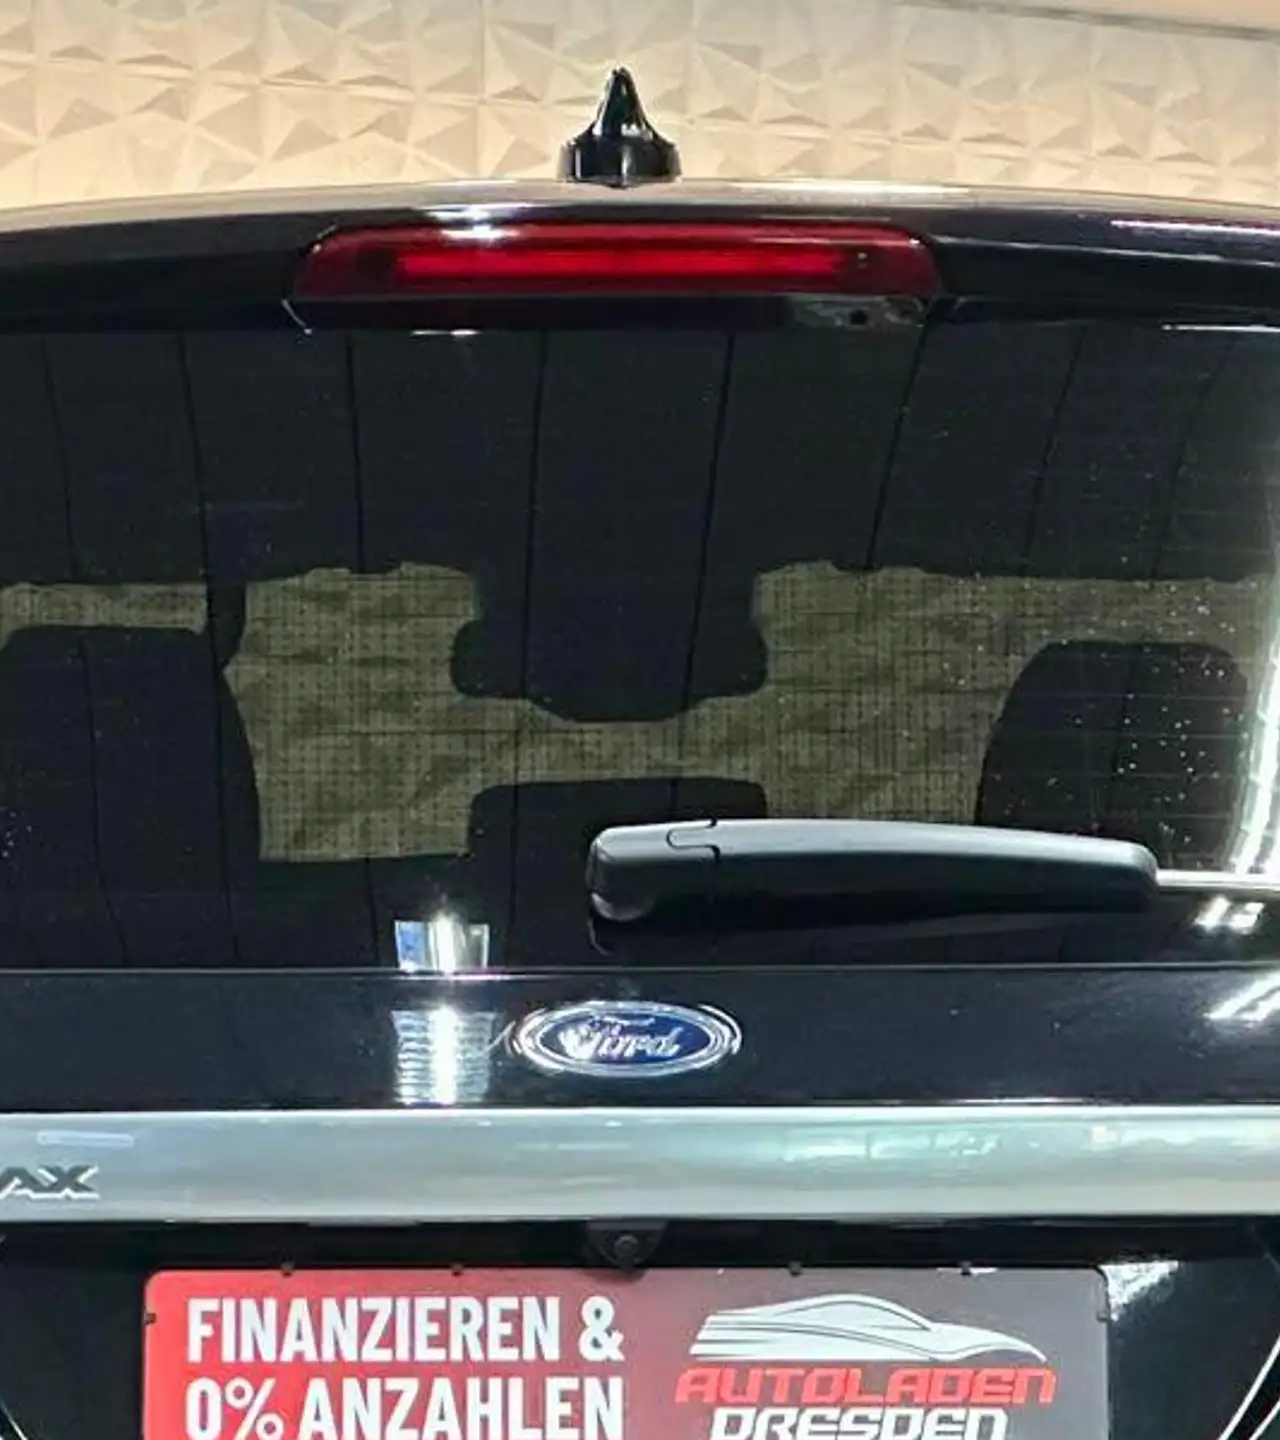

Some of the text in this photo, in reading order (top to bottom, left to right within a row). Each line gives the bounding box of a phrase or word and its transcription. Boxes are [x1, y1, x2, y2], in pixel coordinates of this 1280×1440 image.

[558, 1015, 683, 1061] Ford
[186, 1296, 625, 1363] FINANZIEREN &
[675, 1366, 1055, 1405] AUTOLADEN
